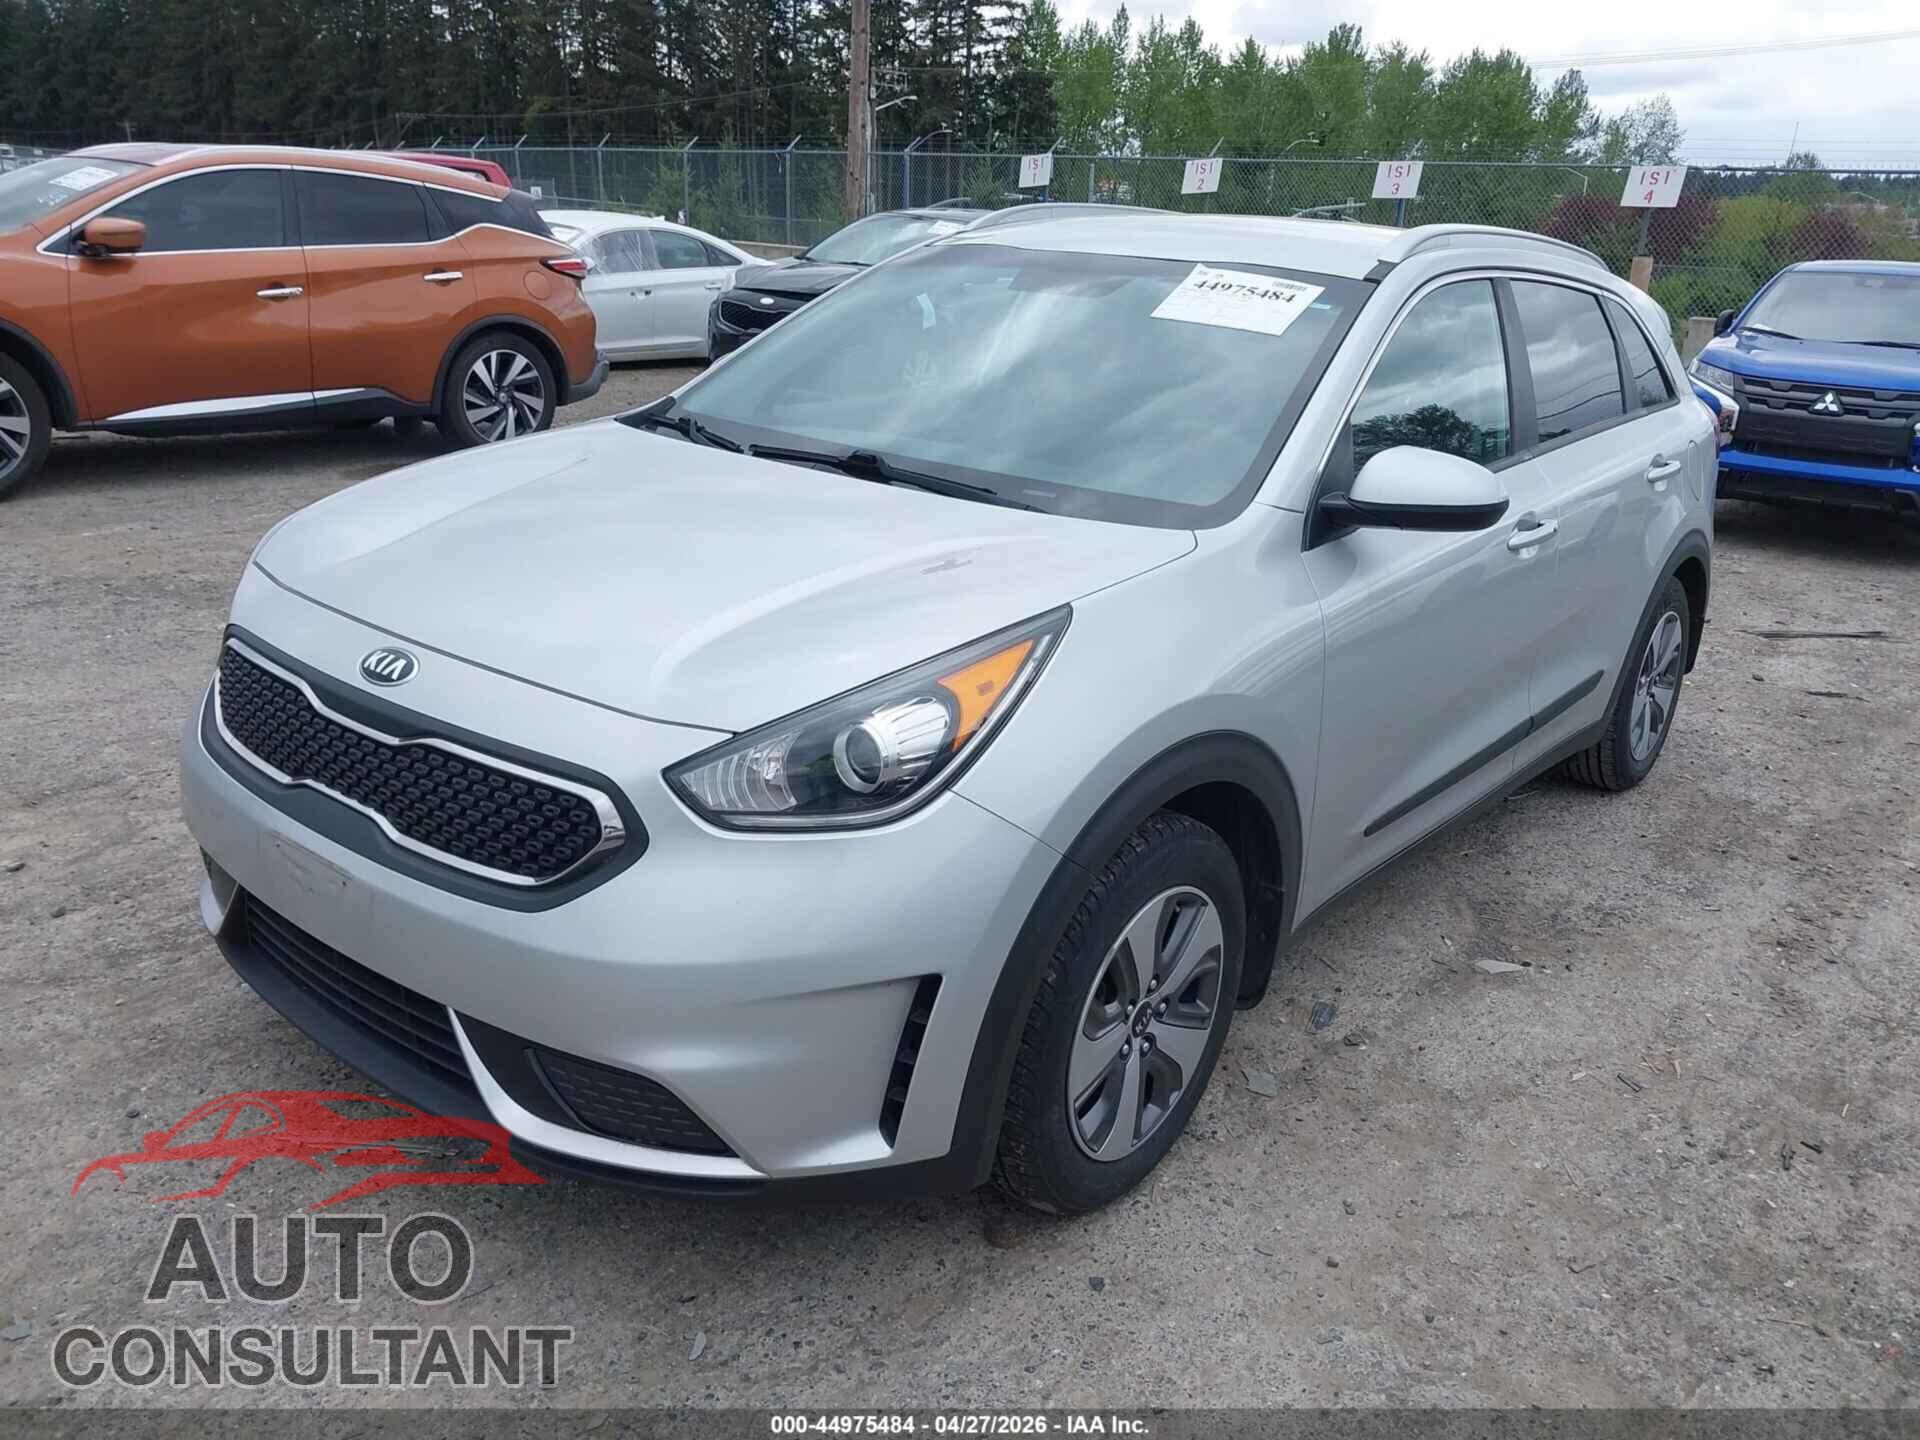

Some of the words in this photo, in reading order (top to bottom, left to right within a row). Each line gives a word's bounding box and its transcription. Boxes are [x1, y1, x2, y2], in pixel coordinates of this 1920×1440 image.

[1197, 178, 1205, 190] 2
[1391, 183, 1400, 195] 3
[1643, 189, 1654, 204] 4
[1193, 279, 1297, 303] 44975484
[362, 649, 408, 681] KIA
[1134, 1007, 1153, 1034] KIA
